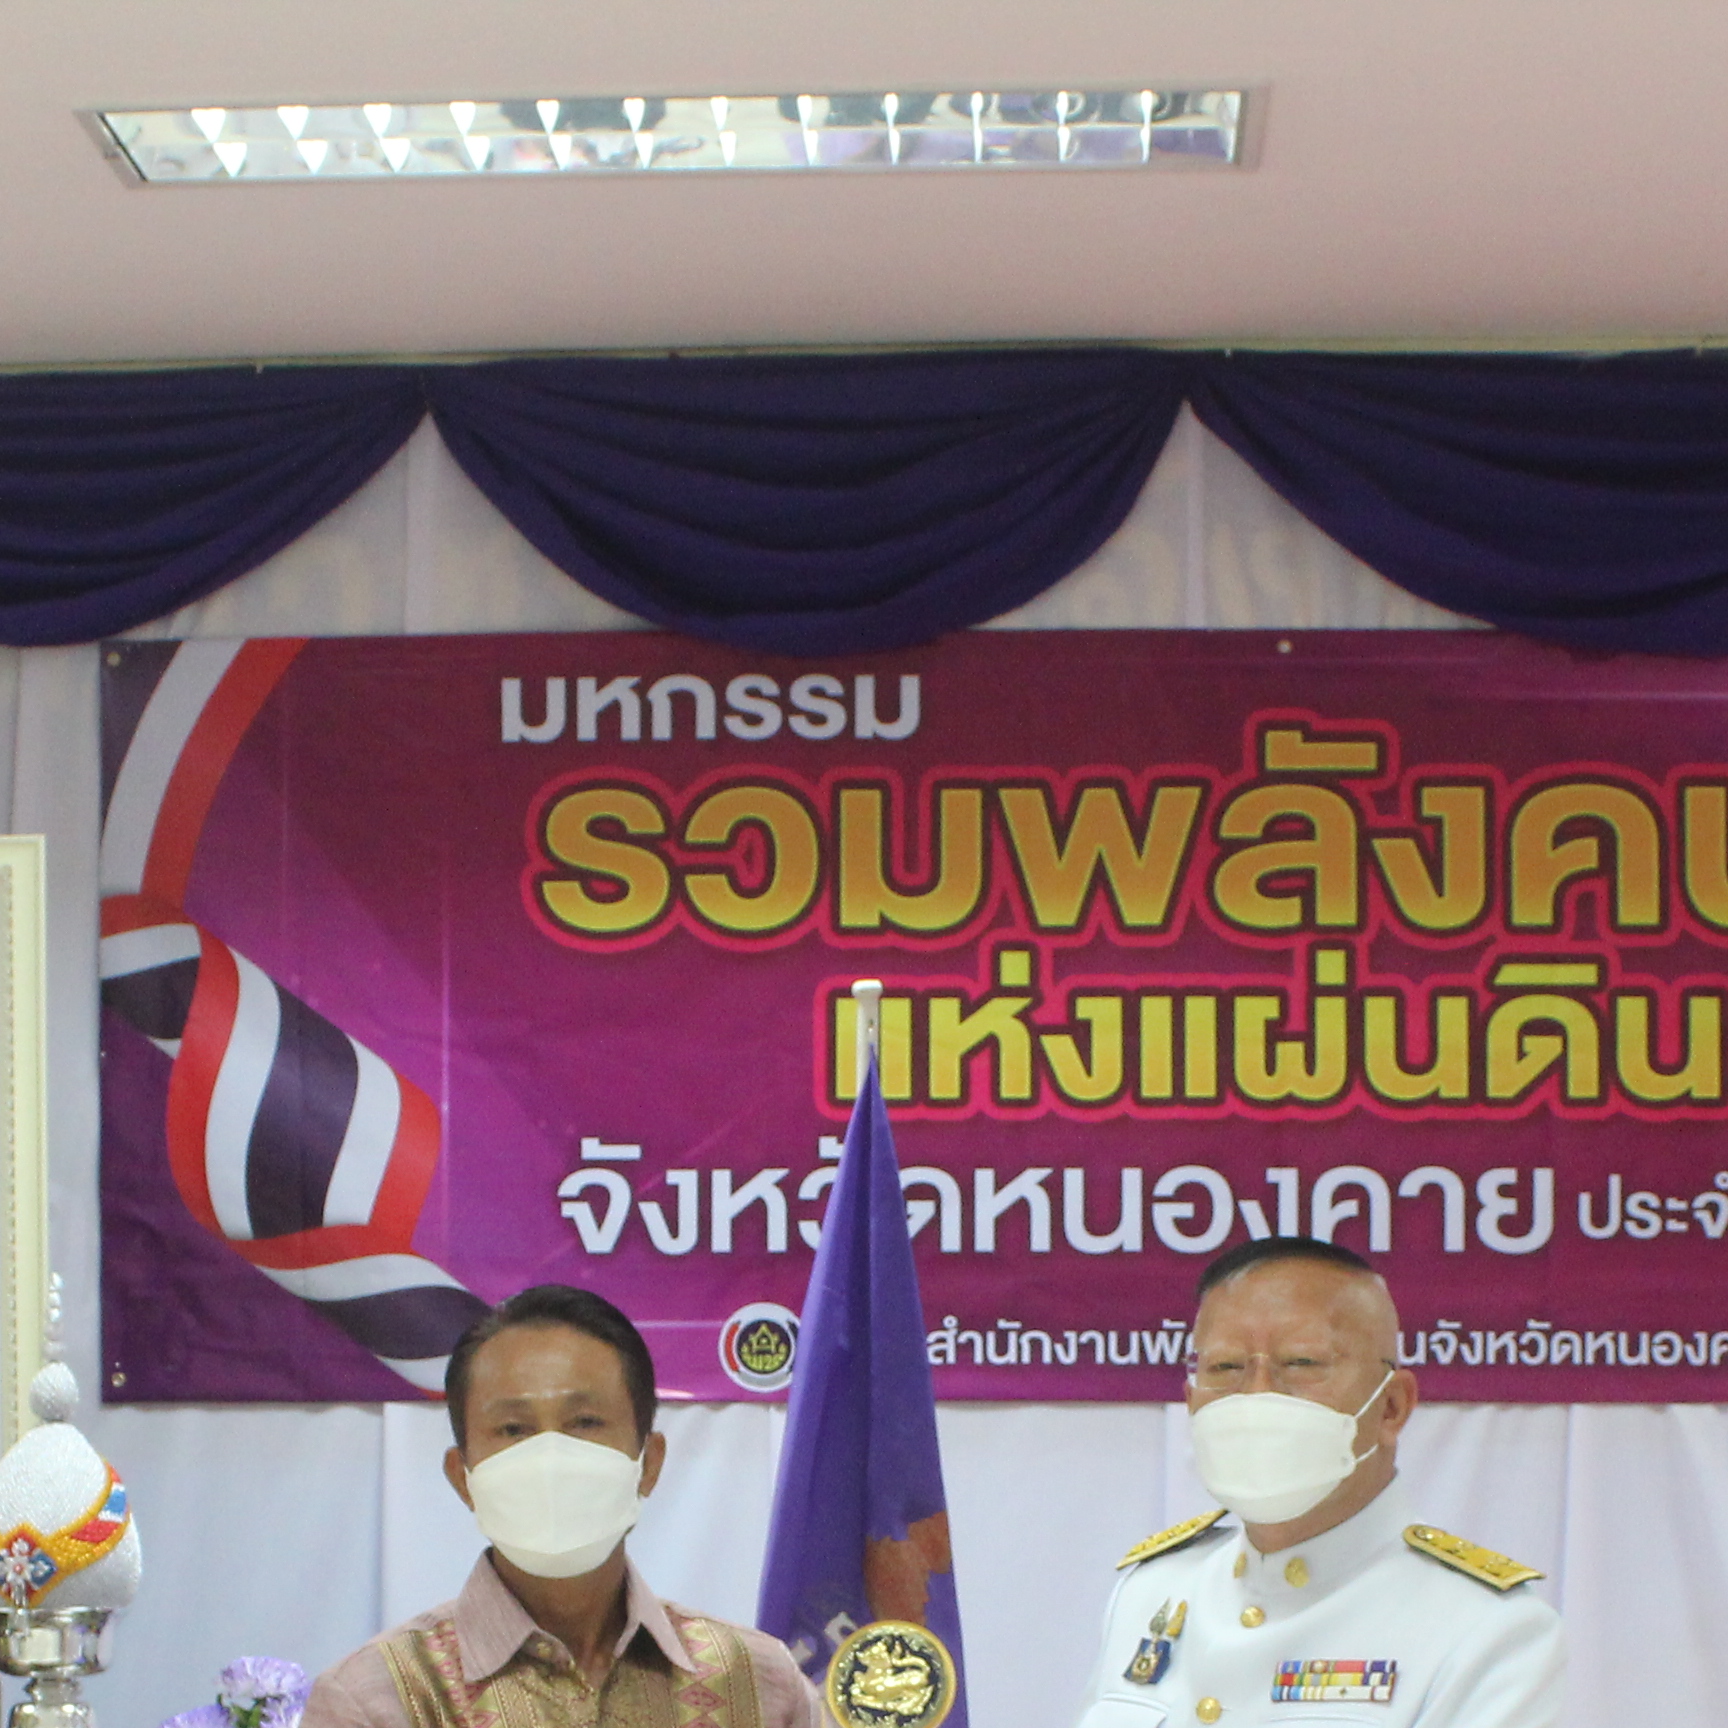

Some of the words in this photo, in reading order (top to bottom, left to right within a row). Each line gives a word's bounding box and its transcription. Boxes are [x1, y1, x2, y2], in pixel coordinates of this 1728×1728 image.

[499, 672, 922, 744] มหกรรม
[830, 946, 1726, 1104] แห่งแผ่นดิน
